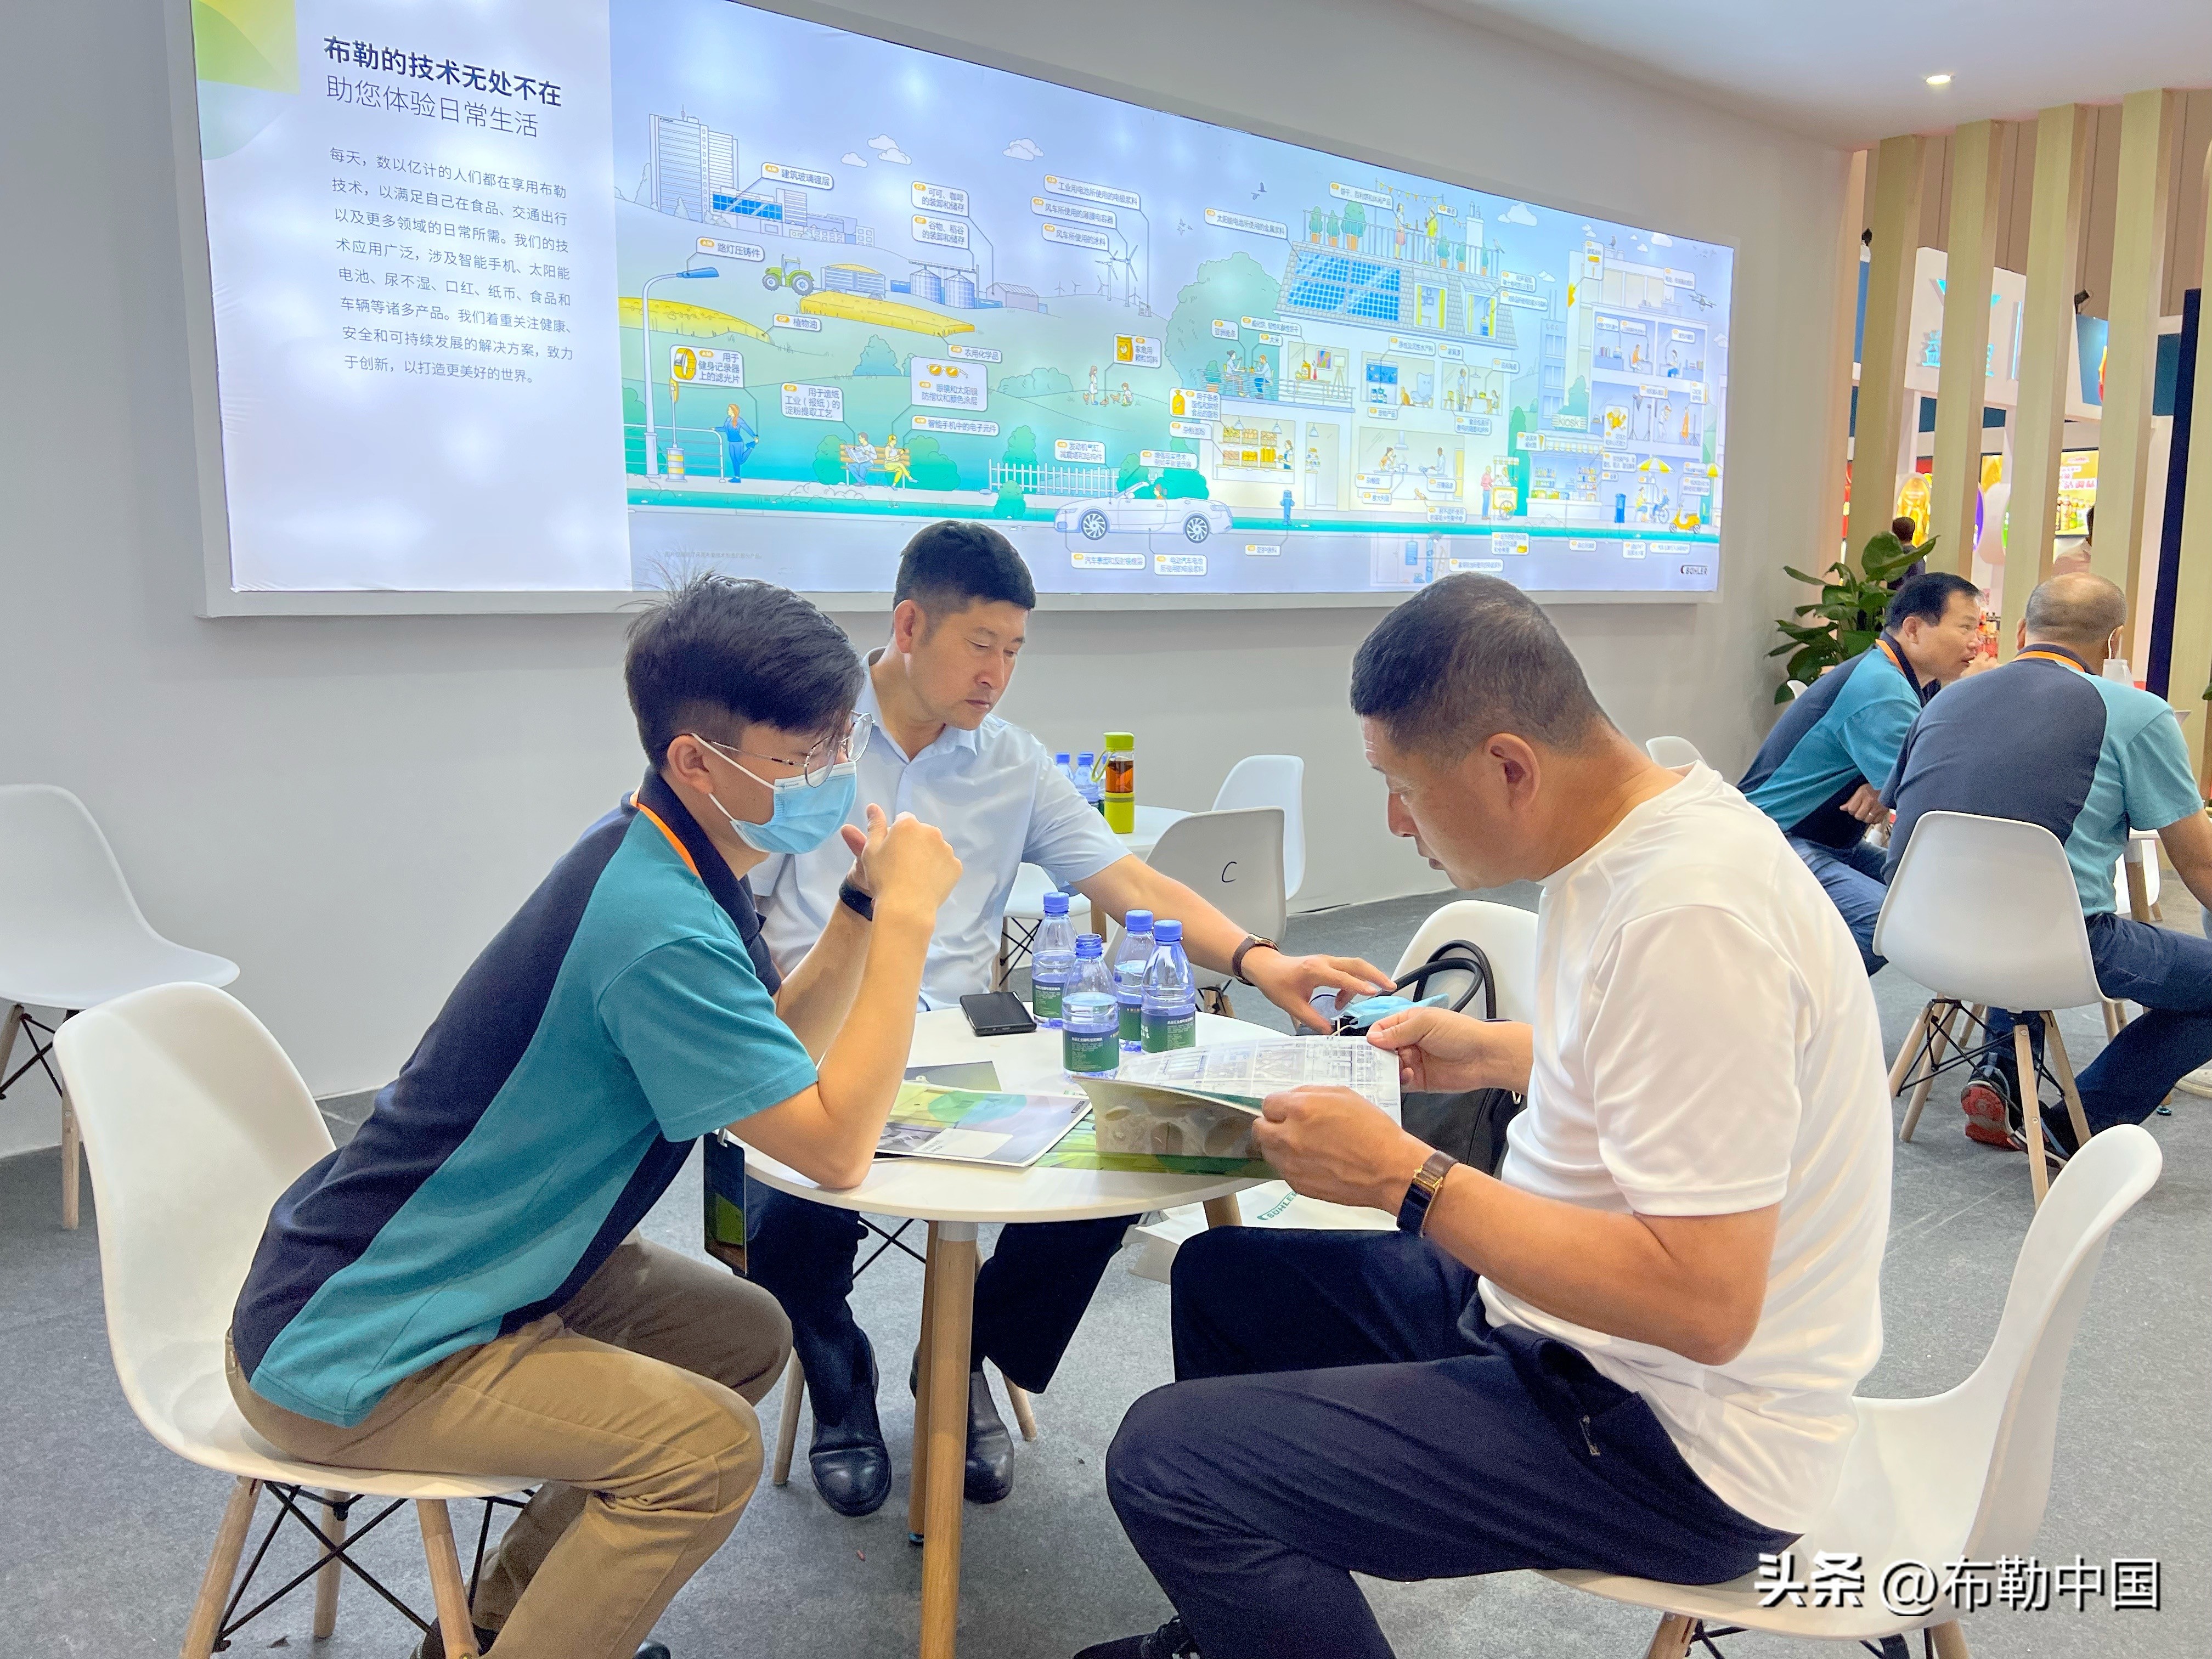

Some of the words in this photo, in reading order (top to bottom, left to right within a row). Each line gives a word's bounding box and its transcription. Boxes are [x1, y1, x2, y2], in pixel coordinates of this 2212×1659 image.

[324, 35, 561, 107] 布勒的技术无处不在
[327, 75, 538, 138] 助您体验日常生活
[330, 147, 566, 199] 每天，数以亿计的人们都在享用布勒
[331, 178, 567, 226] 技术，以满足自己在食品、交通出行
[335, 208, 569, 254] 以及更多领域的日常所需。我们的技
[336, 238, 570, 280] 术应用广泛，涉及智能手机、太阳能
[338, 267, 571, 307] 电池、尿不湿、口红、纸币、食品和
[341, 297, 571, 334] 车辆等诸多产品。我们着重关注健康、
[793, 318, 817, 329] 植物油
[342, 326, 573, 360] 安全和可持续发展的解决方案，致力
[723, 353, 739, 363] 用于
[344, 356, 533, 383] 于创新，以打造更美好的世界。
[808, 387, 840, 399] 用于造纸
[1222, 861, 1237, 883] C
